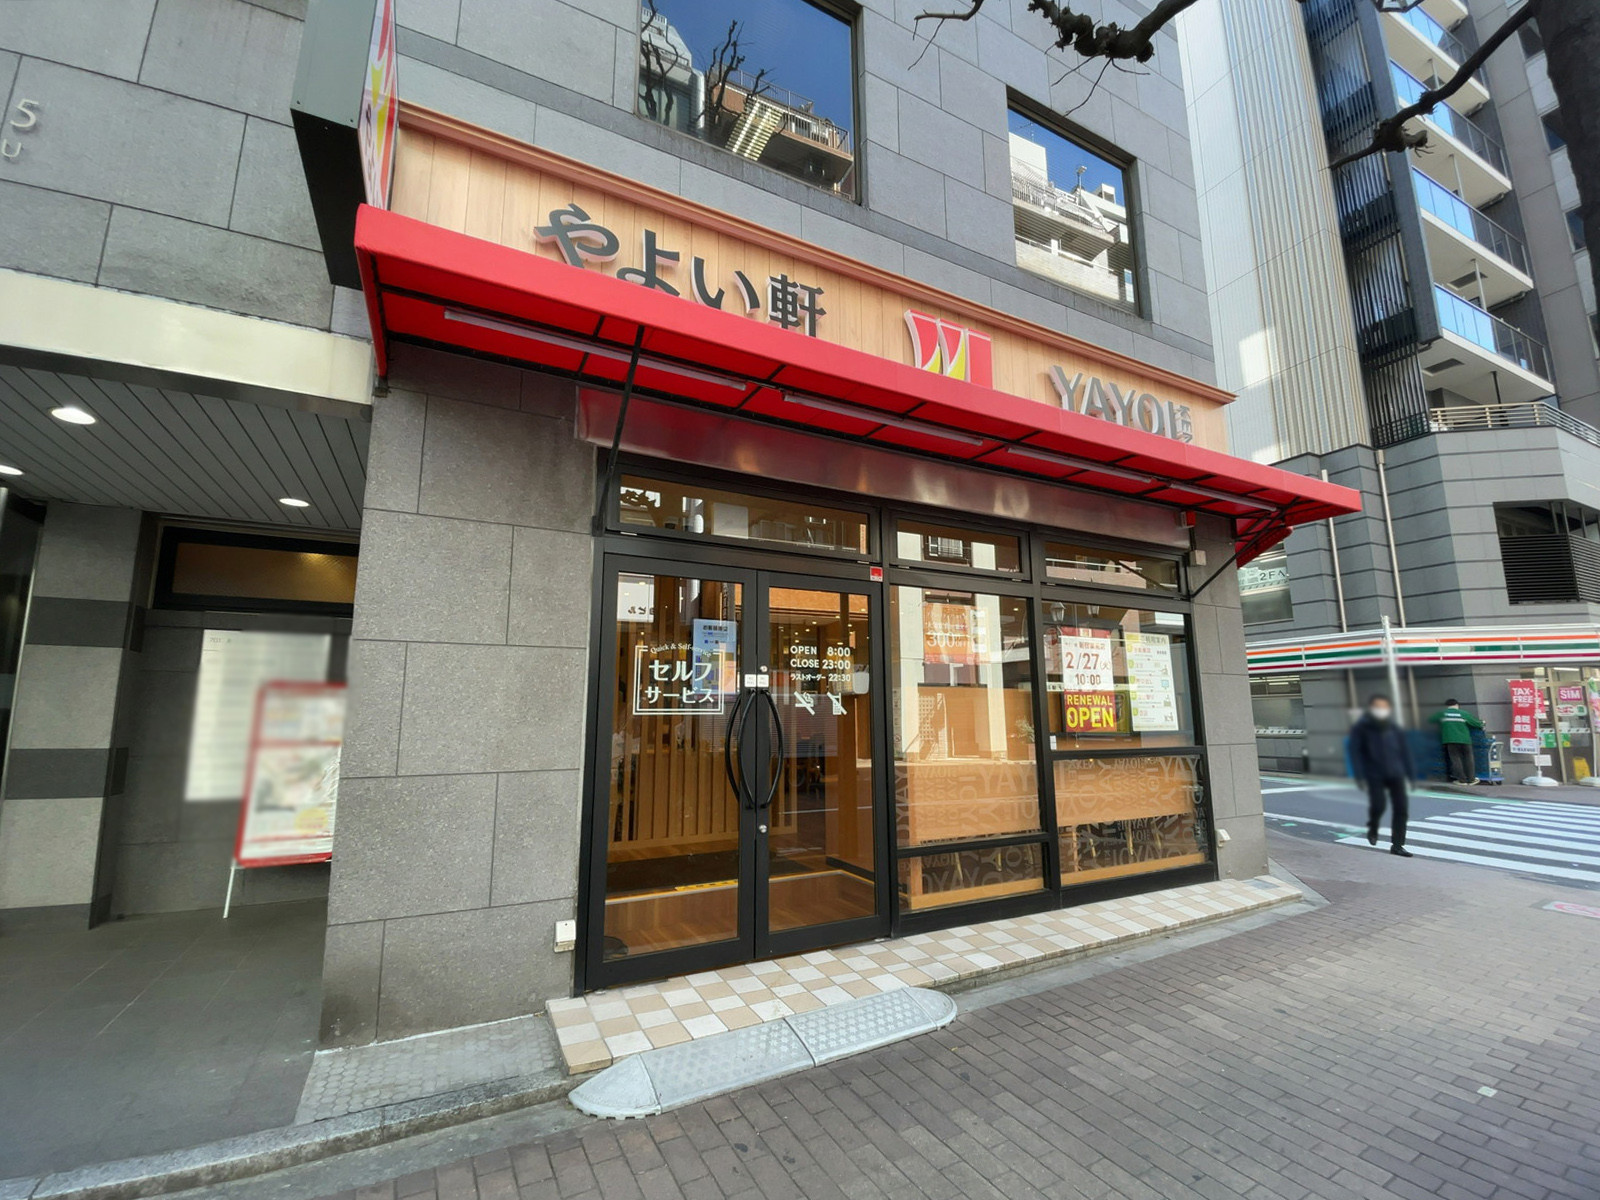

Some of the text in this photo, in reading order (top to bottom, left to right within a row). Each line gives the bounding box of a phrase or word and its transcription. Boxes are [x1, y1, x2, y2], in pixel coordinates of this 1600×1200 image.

[533, 203, 827, 338] やよい軒
[1050, 365, 1177, 440] YAYOI
[789, 645, 852, 657] OPEN 8:00
[648, 659, 713, 682] セルフ
[789, 659, 852, 670] CLOSE 23:00
[828, 674, 852, 682] 22:30
[1075, 674, 1102, 686] 10:00
[644, 685, 715, 704] サービス
[1066, 694, 1114, 706] RENEWAL
[1512, 695, 1534, 704] FREE
[1559, 689, 1581, 700] SIM
[1066, 706, 1115, 728] OPEN
